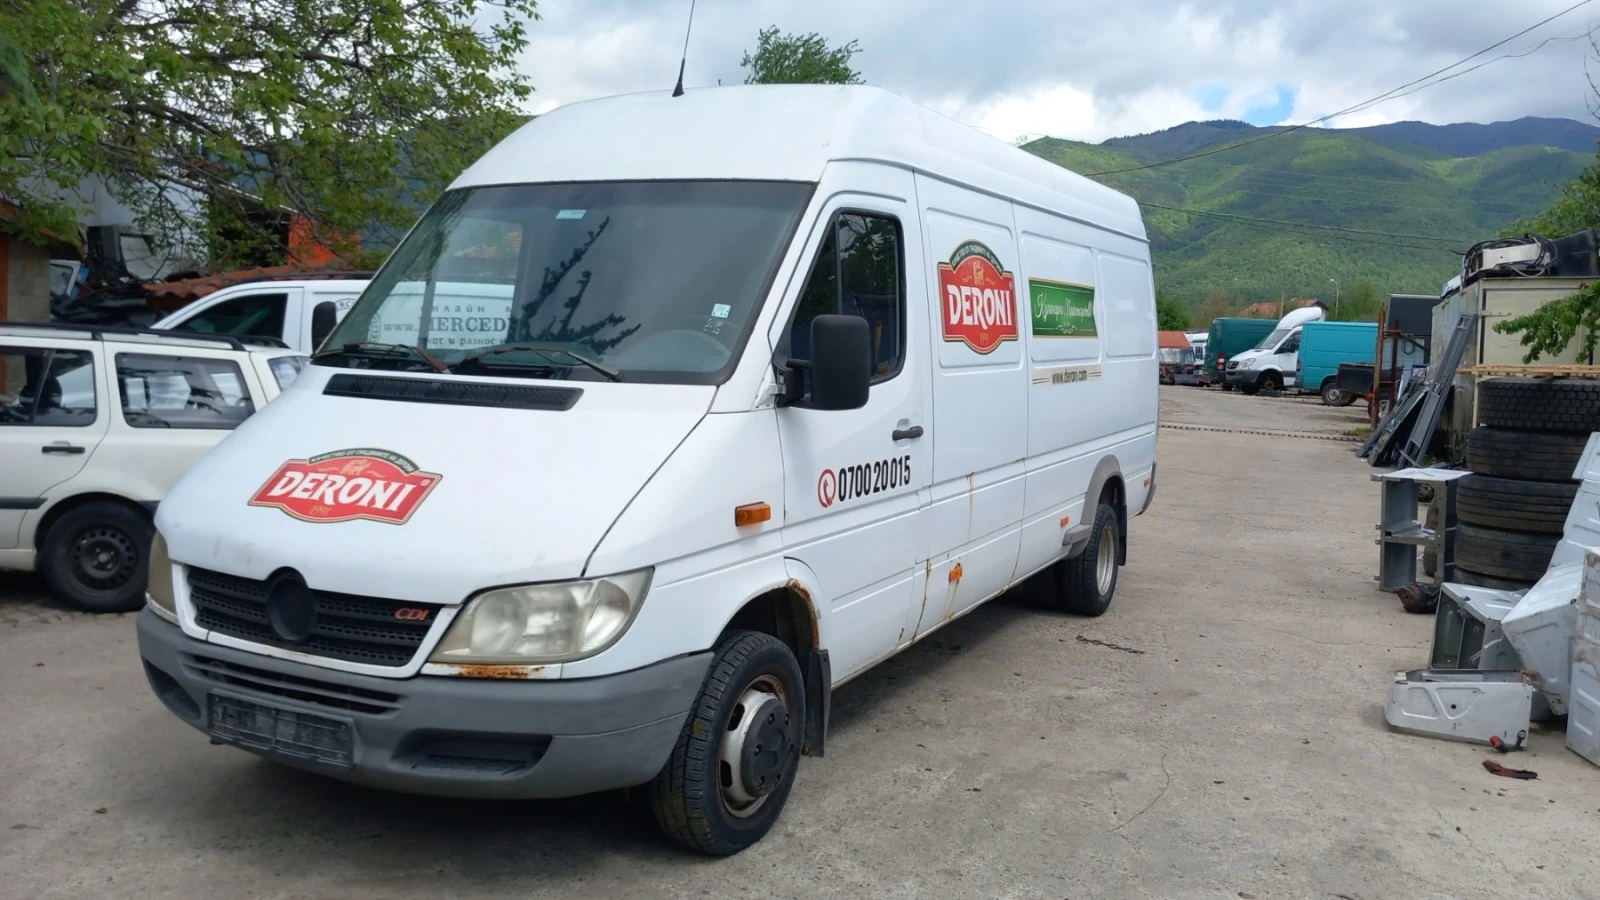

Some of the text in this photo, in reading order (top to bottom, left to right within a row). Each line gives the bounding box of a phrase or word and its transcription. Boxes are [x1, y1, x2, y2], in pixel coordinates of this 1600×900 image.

[421, 304, 485, 312] нлайн
[947, 284, 1012, 330] DERONI
[1052, 368, 1088, 385] www.deroni.com
[267, 471, 417, 512] DERONI
[395, 608, 430, 621] CDI
